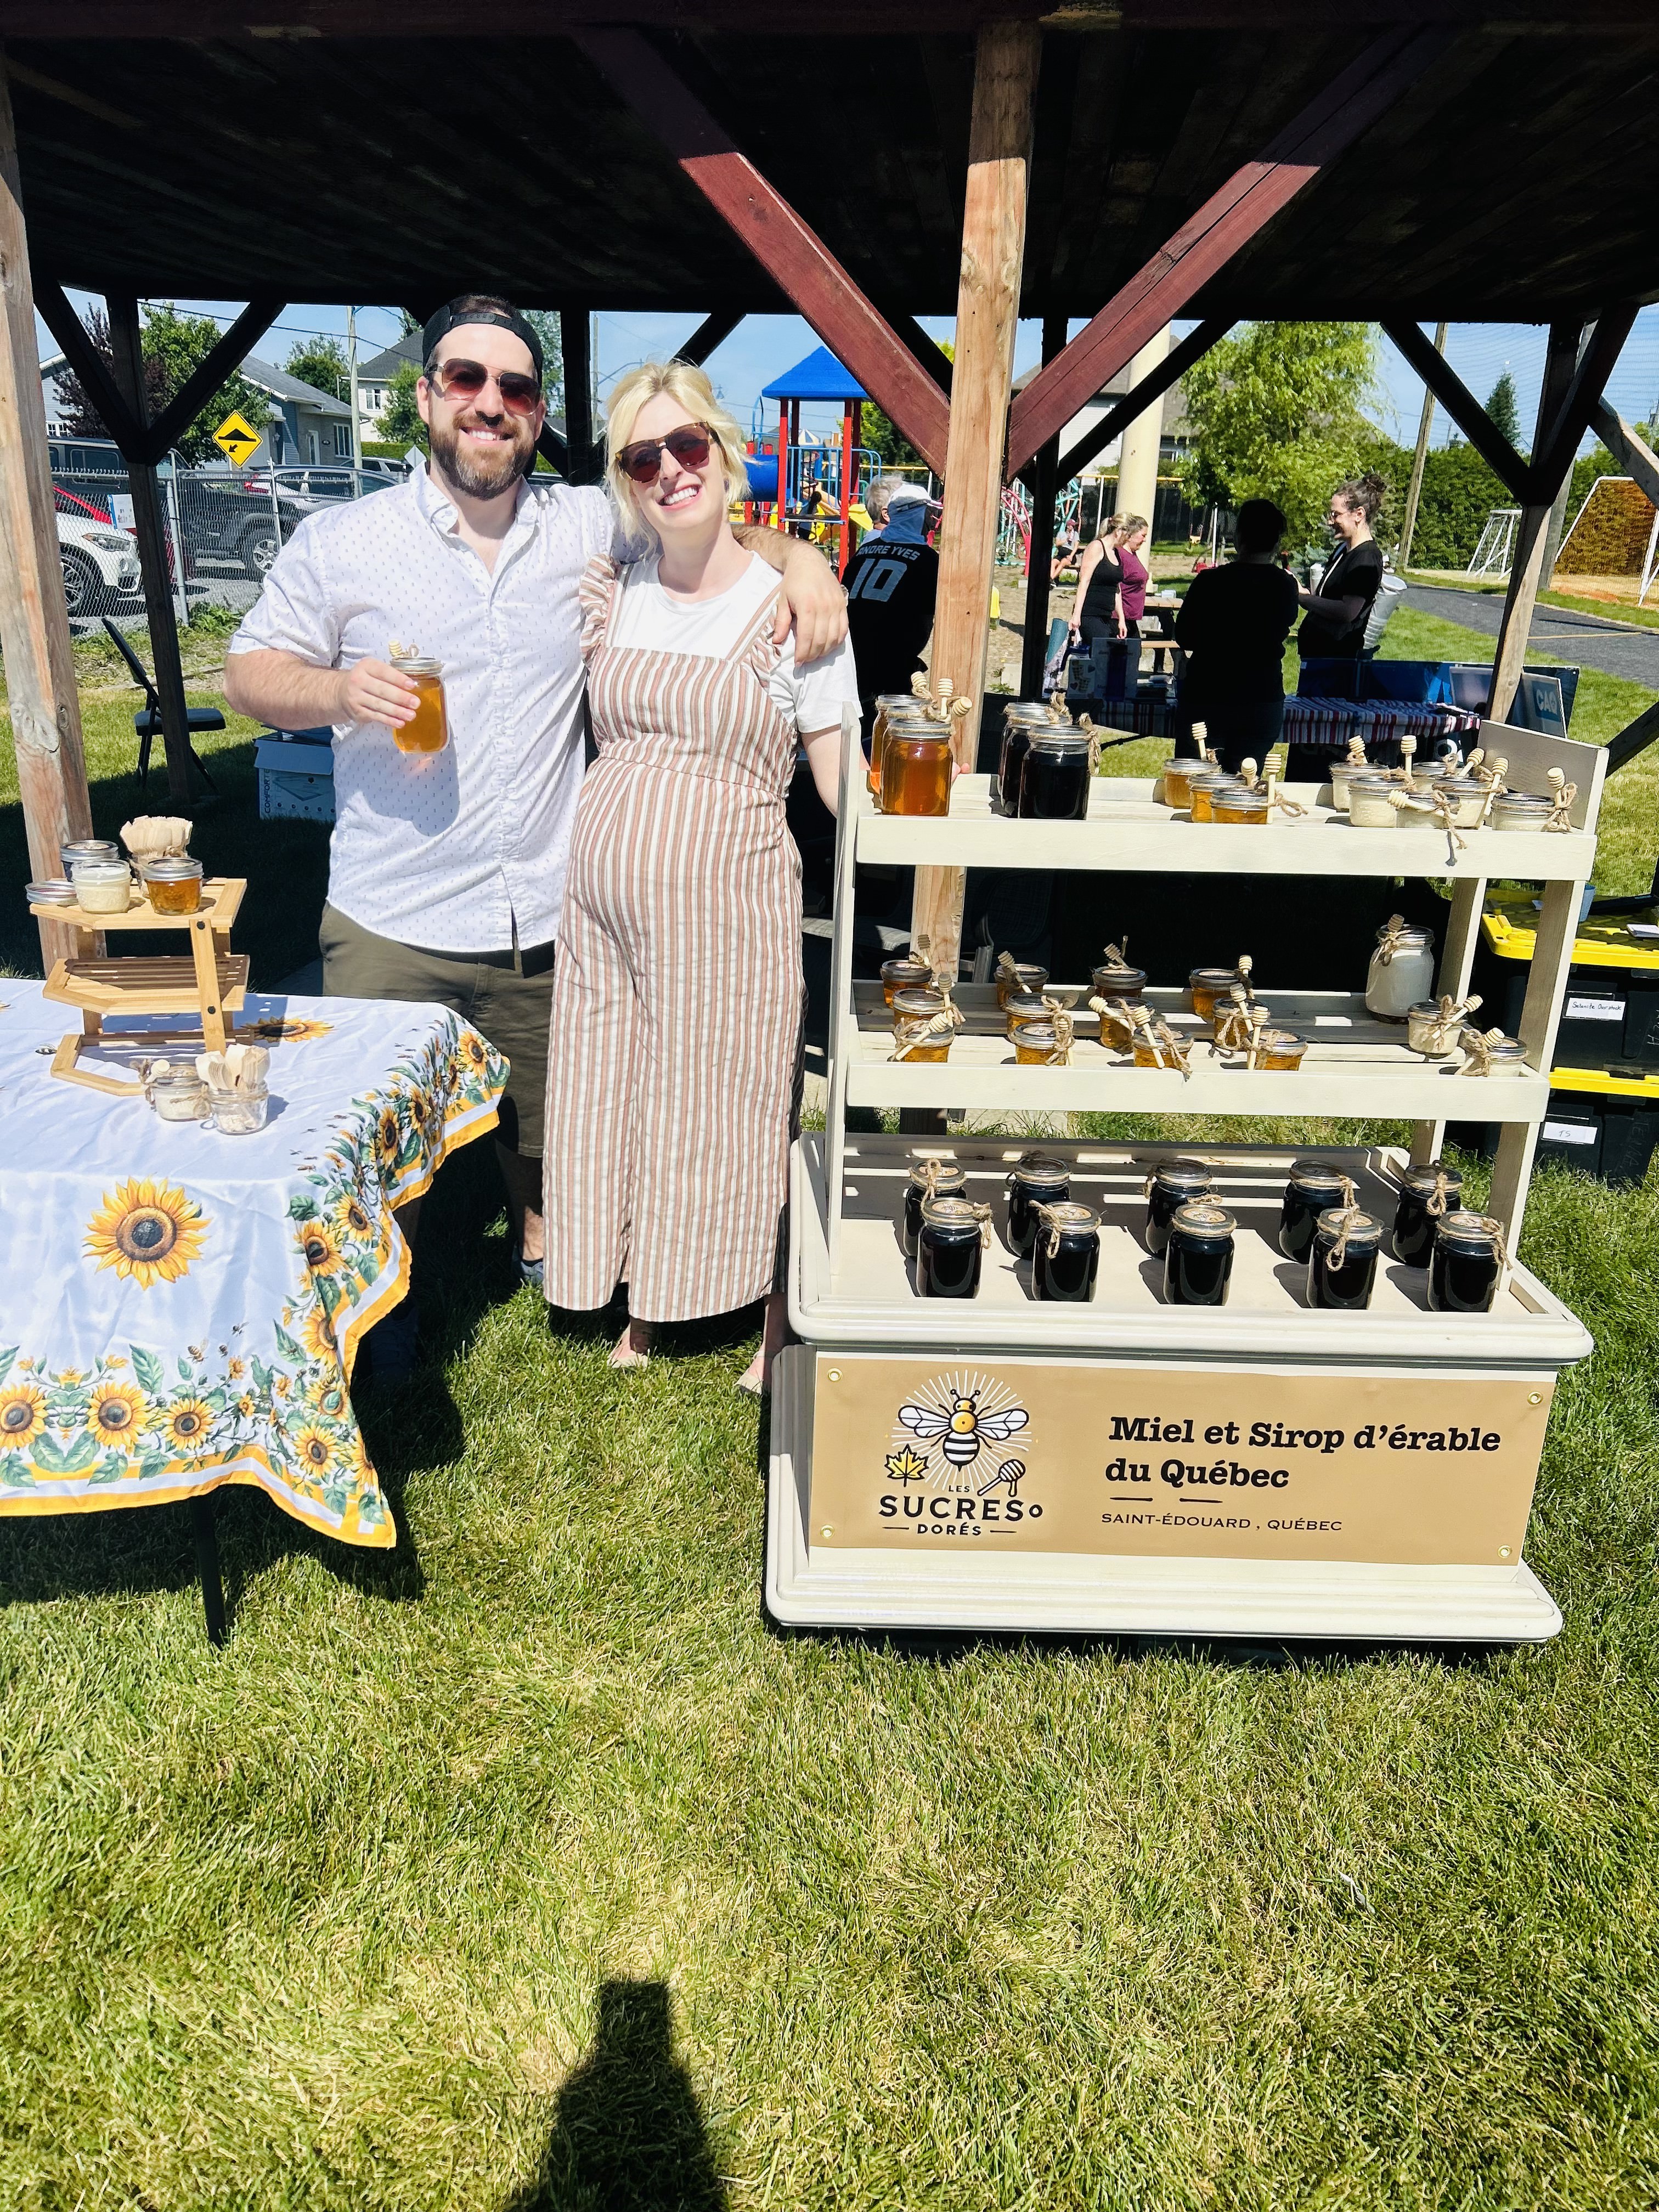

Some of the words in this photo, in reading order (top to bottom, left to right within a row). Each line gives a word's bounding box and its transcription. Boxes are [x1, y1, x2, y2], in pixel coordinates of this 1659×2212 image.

[857, 545, 890, 556] ANDRE
[891, 546, 921, 561] YVES
[849, 558, 908, 602] 10
[1108, 1416, 1195, 1443] Miel
[1204, 1421, 1240, 1445] et
[1248, 1421, 1345, 1454] Sirop
[1353, 1424, 1501, 1452] d’érable
[1105, 1458, 1152, 1482] du
[1160, 1459, 1289, 1488] Québec
[948, 1485, 970, 1493] LES
[917, 1521, 981, 1536] DORÉS
[1101, 1513, 1251, 1528] SAINT-ÉDOUARD
[1267, 1517, 1342, 1531] QUÉBEC
